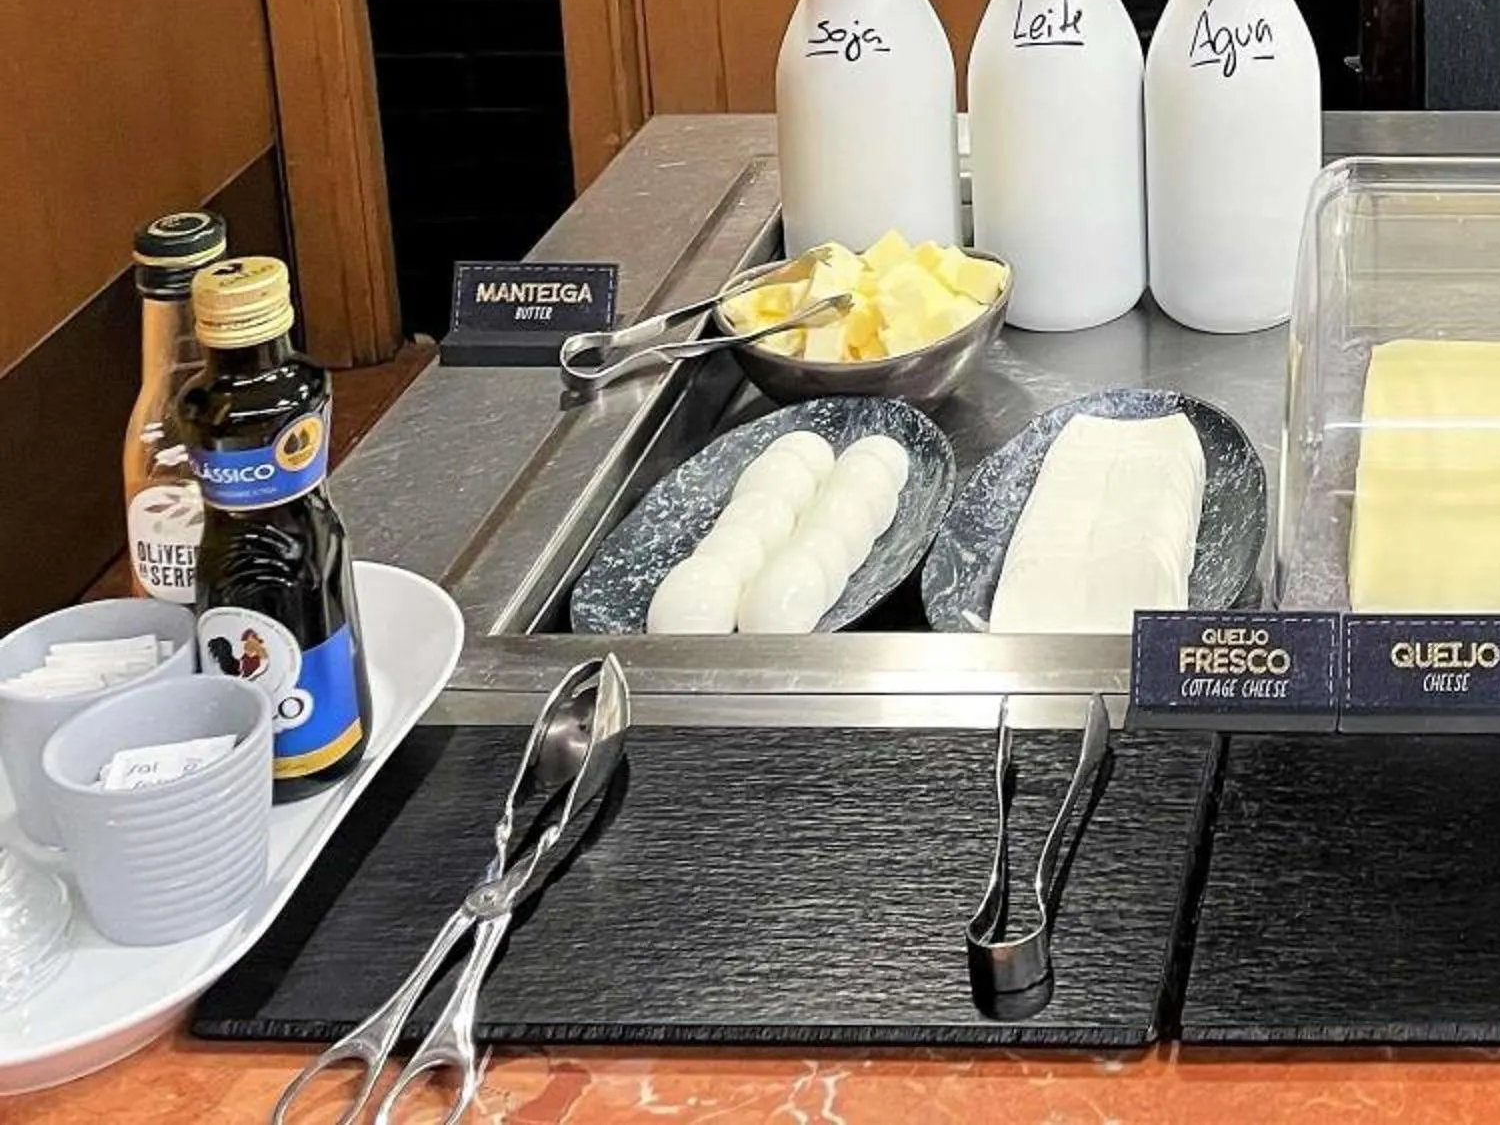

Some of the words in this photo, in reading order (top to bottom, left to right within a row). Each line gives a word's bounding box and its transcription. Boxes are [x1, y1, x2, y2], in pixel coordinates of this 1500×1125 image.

[475, 282, 593, 303] MANTEIGA
[515, 306, 553, 320] BUTTER
[1201, 628, 1269, 645] QUEIJO
[1179, 648, 1291, 675] FRESCO
[1391, 641, 1500, 669] QUEIJO
[1181, 679, 1241, 699] COTTAGE
[1243, 679, 1290, 699] CHEESE
[1423, 672, 1470, 693] CHEESE
